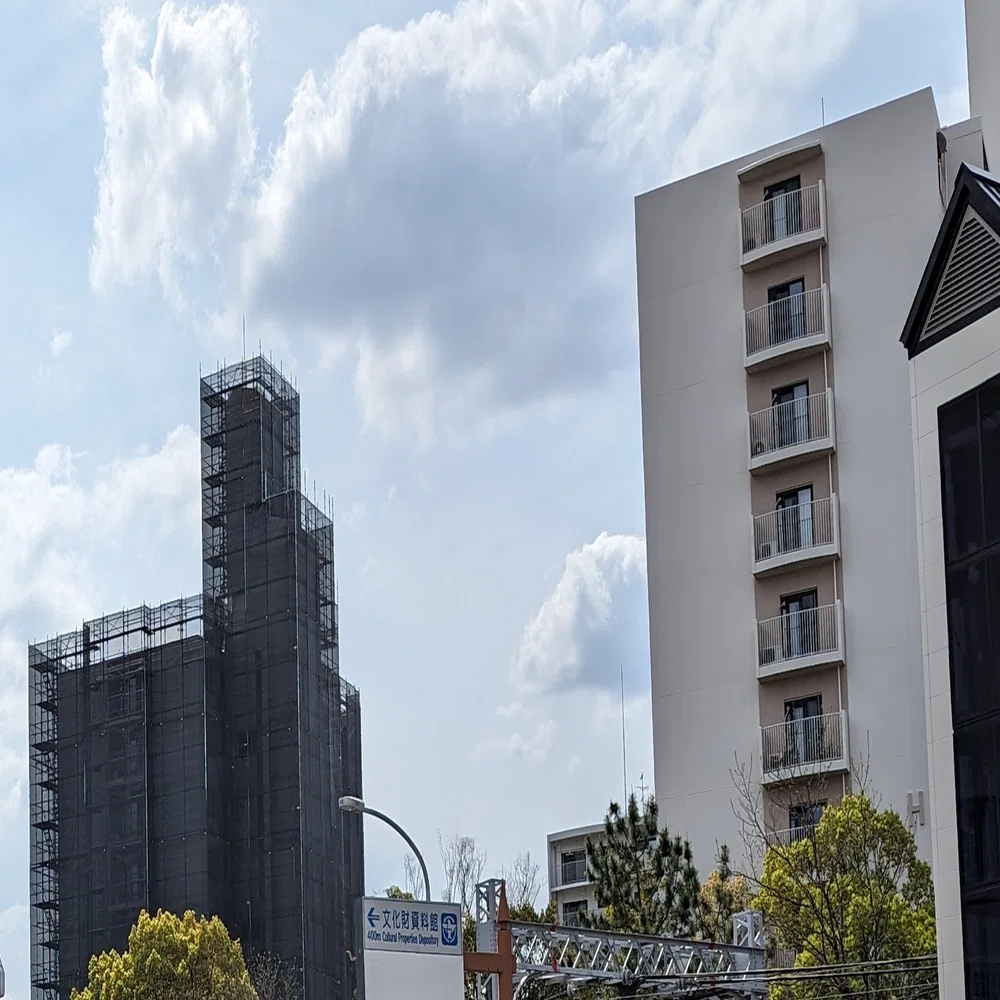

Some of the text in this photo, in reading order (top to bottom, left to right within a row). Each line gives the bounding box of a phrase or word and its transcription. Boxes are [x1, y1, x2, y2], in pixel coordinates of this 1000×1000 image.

[382, 909, 439, 932] 文化財資料館
